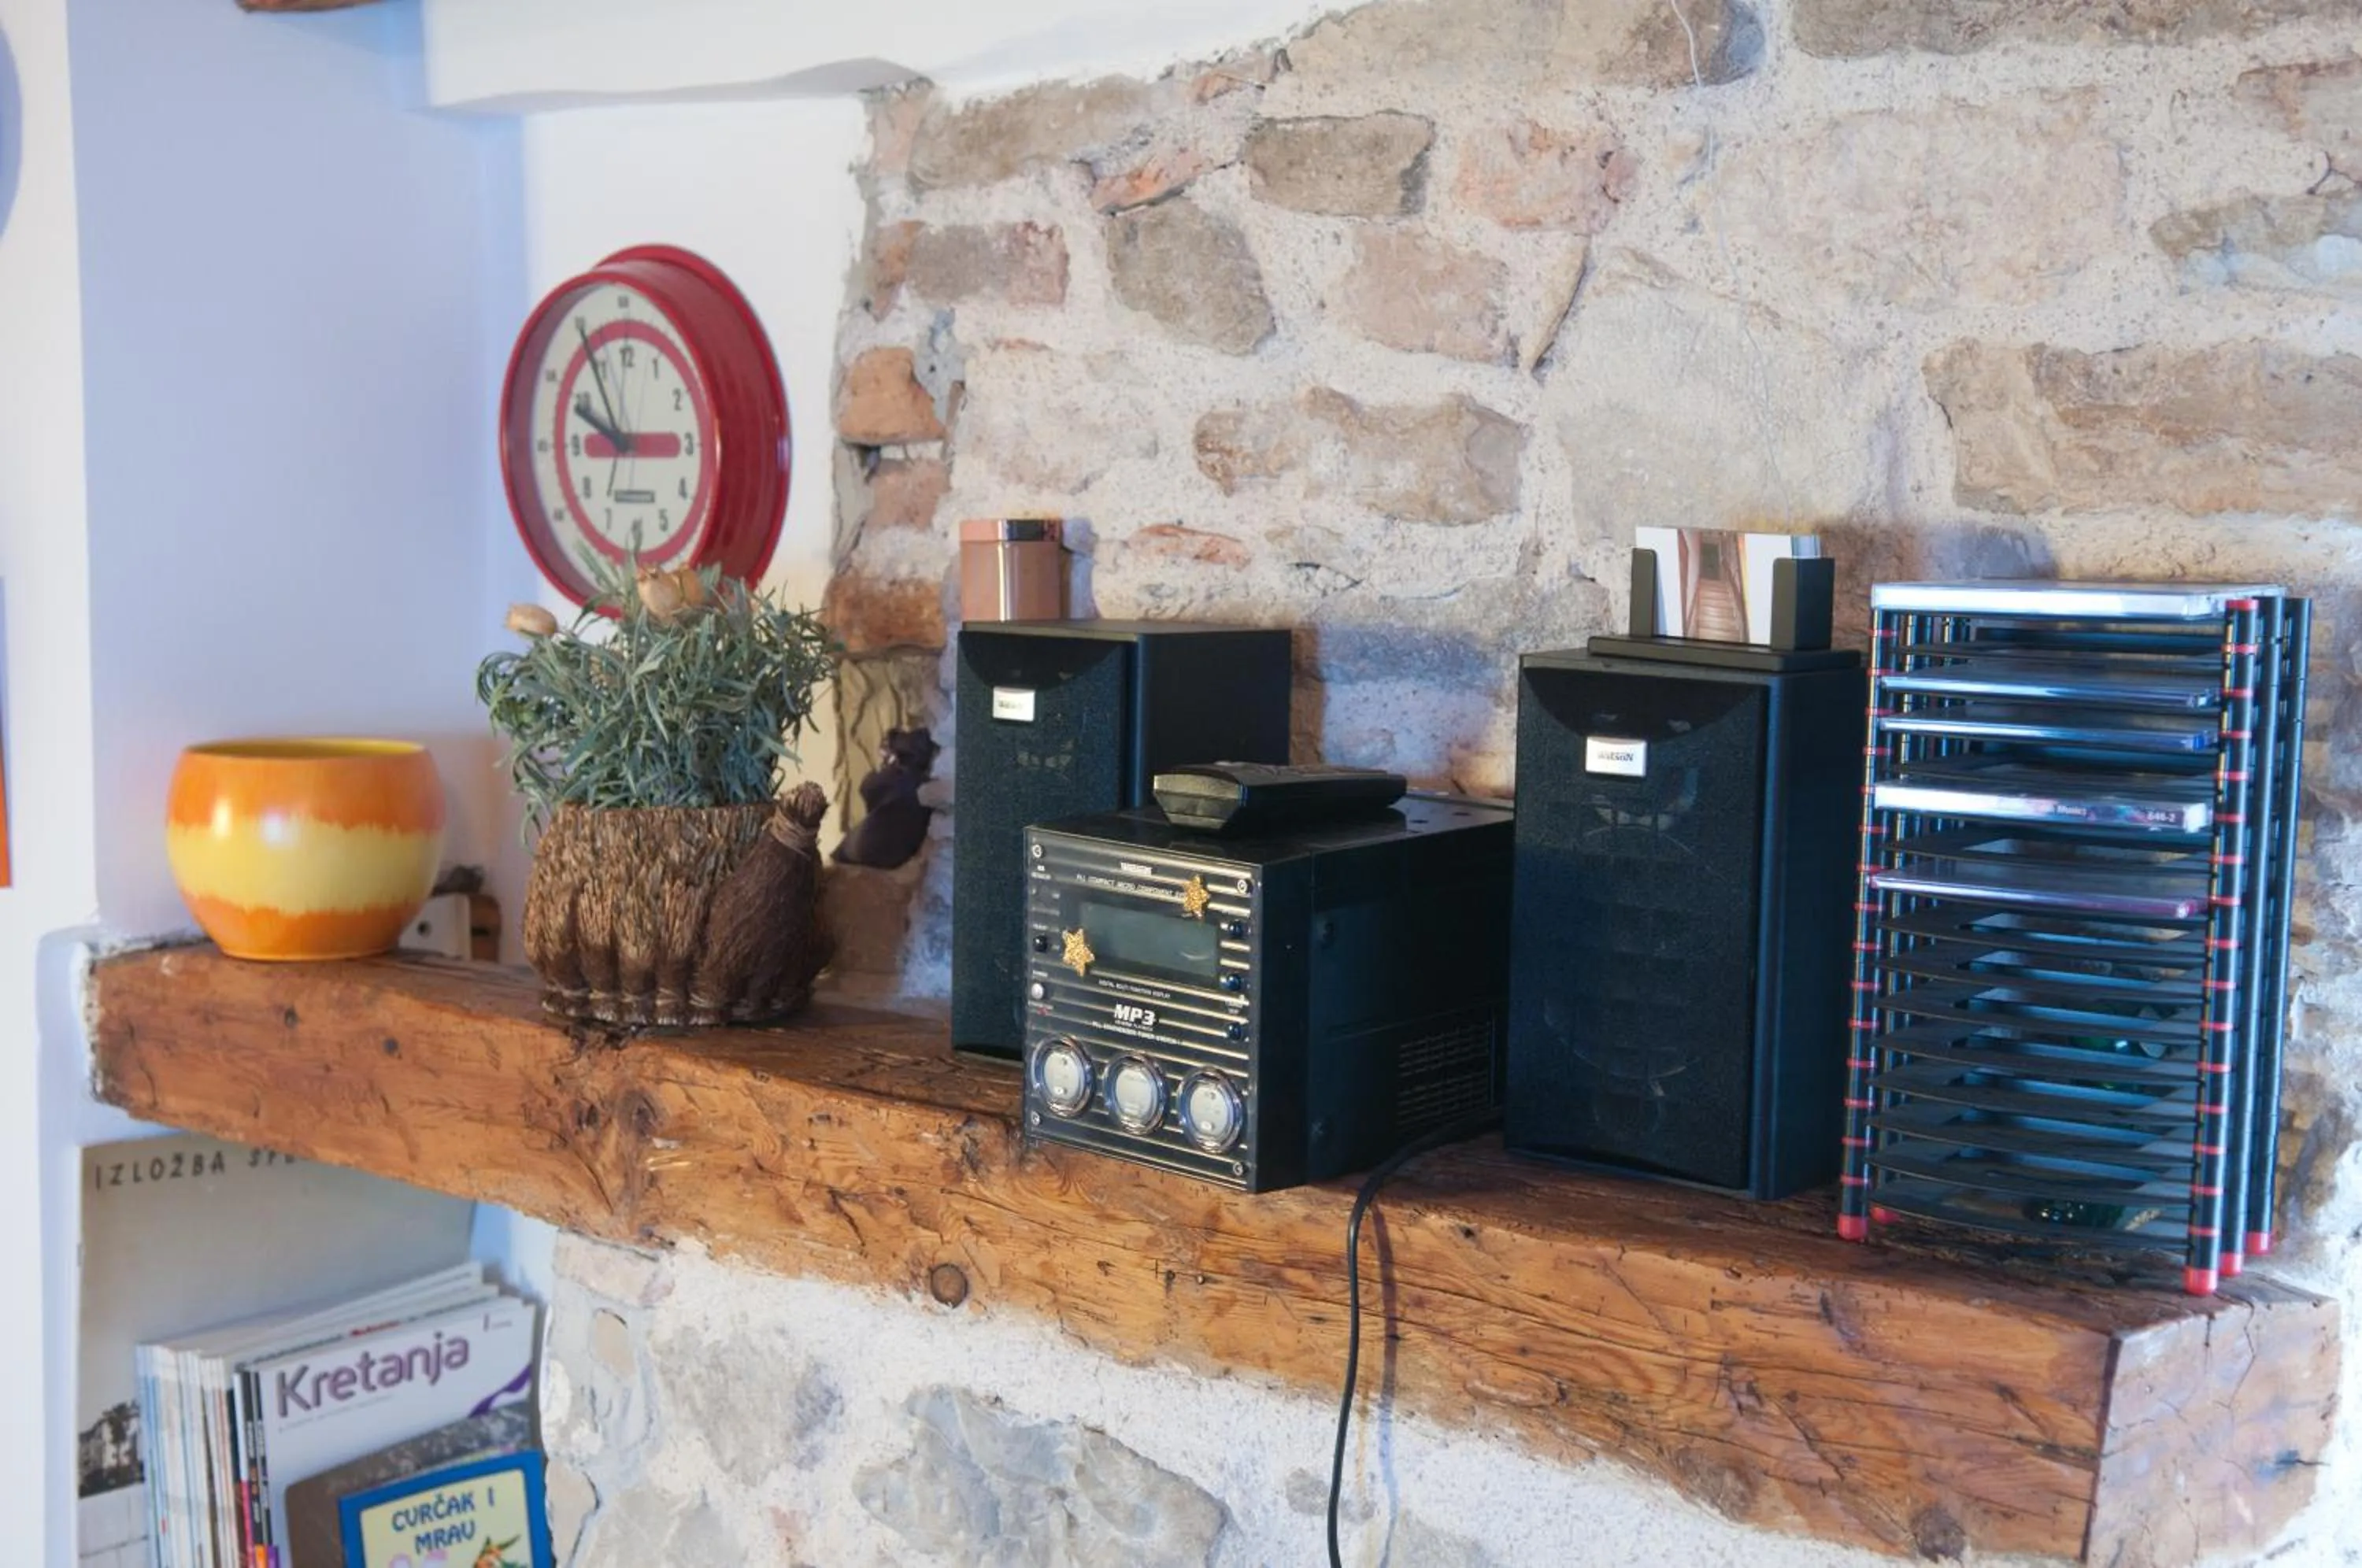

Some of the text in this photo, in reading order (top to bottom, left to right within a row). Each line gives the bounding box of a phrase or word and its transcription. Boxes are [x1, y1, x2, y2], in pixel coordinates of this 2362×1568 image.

[619, 346, 635, 369] 12
[652, 357, 660, 381] 1
[672, 387, 683, 411] 2
[684, 431, 694, 457] 3
[678, 477, 688, 501] 4
[605, 507, 613, 531] 7
[658, 508, 669, 532] 5
[1114, 1003, 1157, 1026] MP3
[277, 1331, 470, 1418] Kretanja
